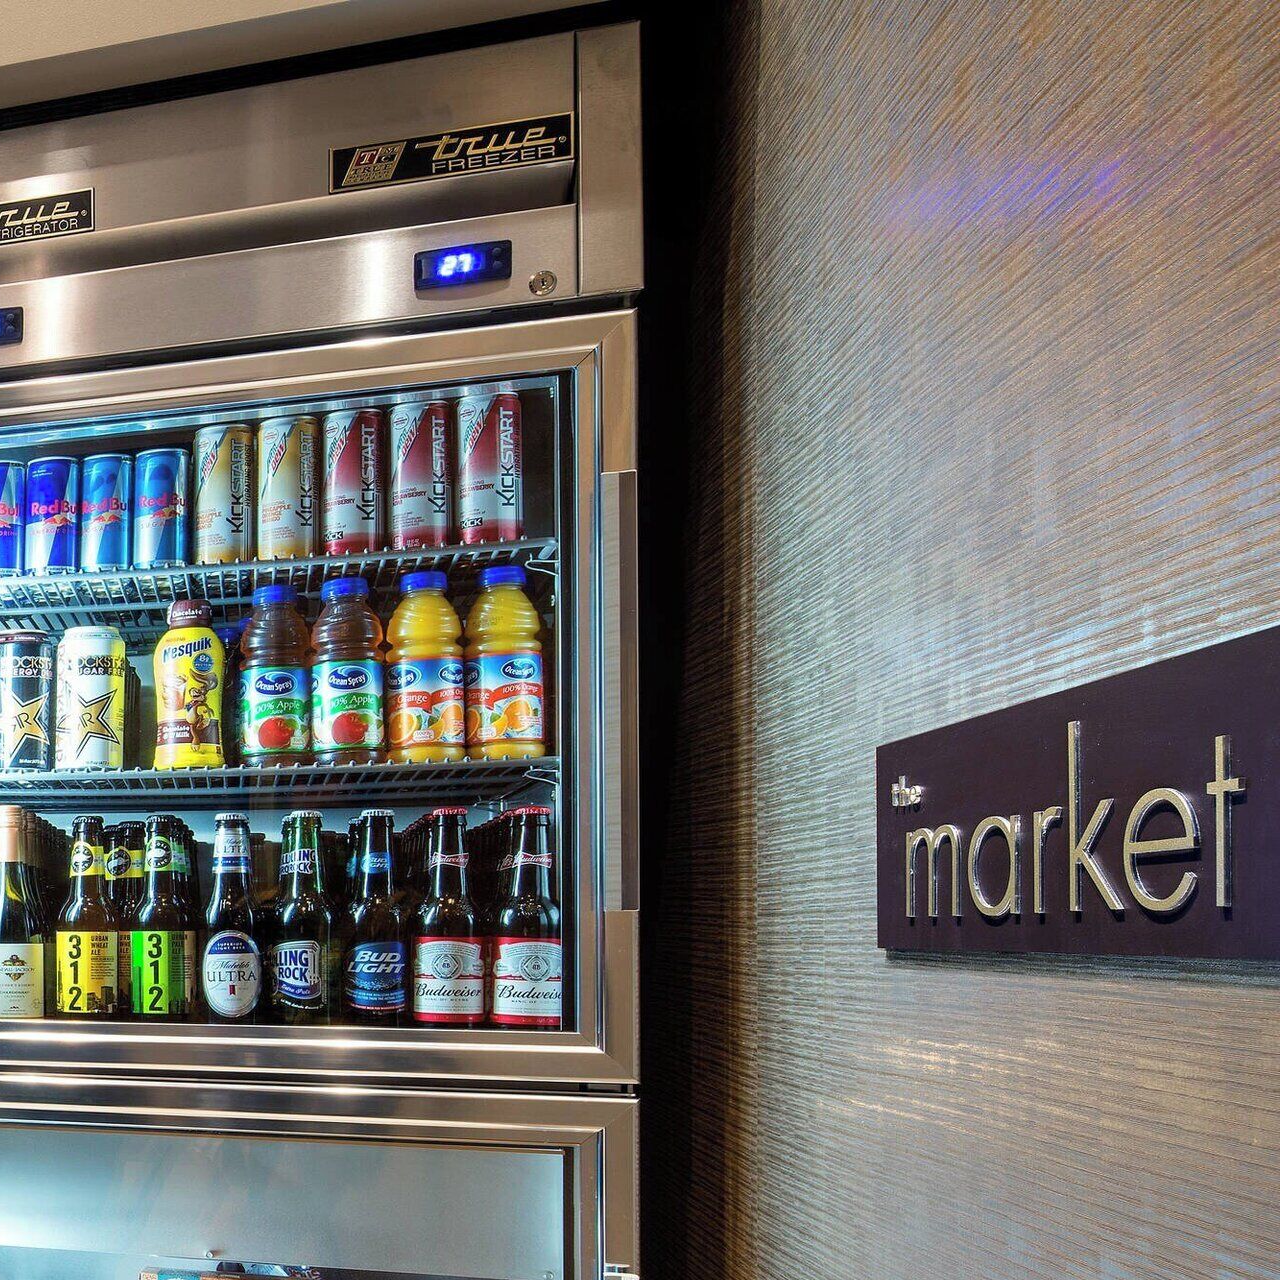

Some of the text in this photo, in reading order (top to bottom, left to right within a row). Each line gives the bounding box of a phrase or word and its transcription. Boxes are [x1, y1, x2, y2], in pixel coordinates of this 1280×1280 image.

[415, 127, 556, 160] true
[432, 146, 556, 173] FREEZER
[437, 253, 473, 277] 27
[427, 415, 446, 514] KICKSTART
[495, 406, 515, 507] KICKSTART
[225, 438, 245, 534] KICKSTART
[295, 431, 313, 527] KICKSTART
[356, 424, 376, 521] KICKSTART
[31, 500, 59, 516] Red
[163, 636, 213, 664] Nesquik
[275, 700, 301, 713] Apple
[350, 695, 375, 708] Apple
[397, 692, 428, 704] Orange
[891, 775, 925, 808] the
[905, 720, 1248, 919] market
[431, 852, 469, 866] Budweiser
[347, 962, 405, 974] LIGHT
[354, 950, 401, 962] BUD
[68, 934, 83, 1012] 312
[147, 933, 164, 1012] 312
[206, 970, 258, 983] ULTRA
[279, 966, 309, 983] ROCK
[414, 982, 483, 998] Budweiser
